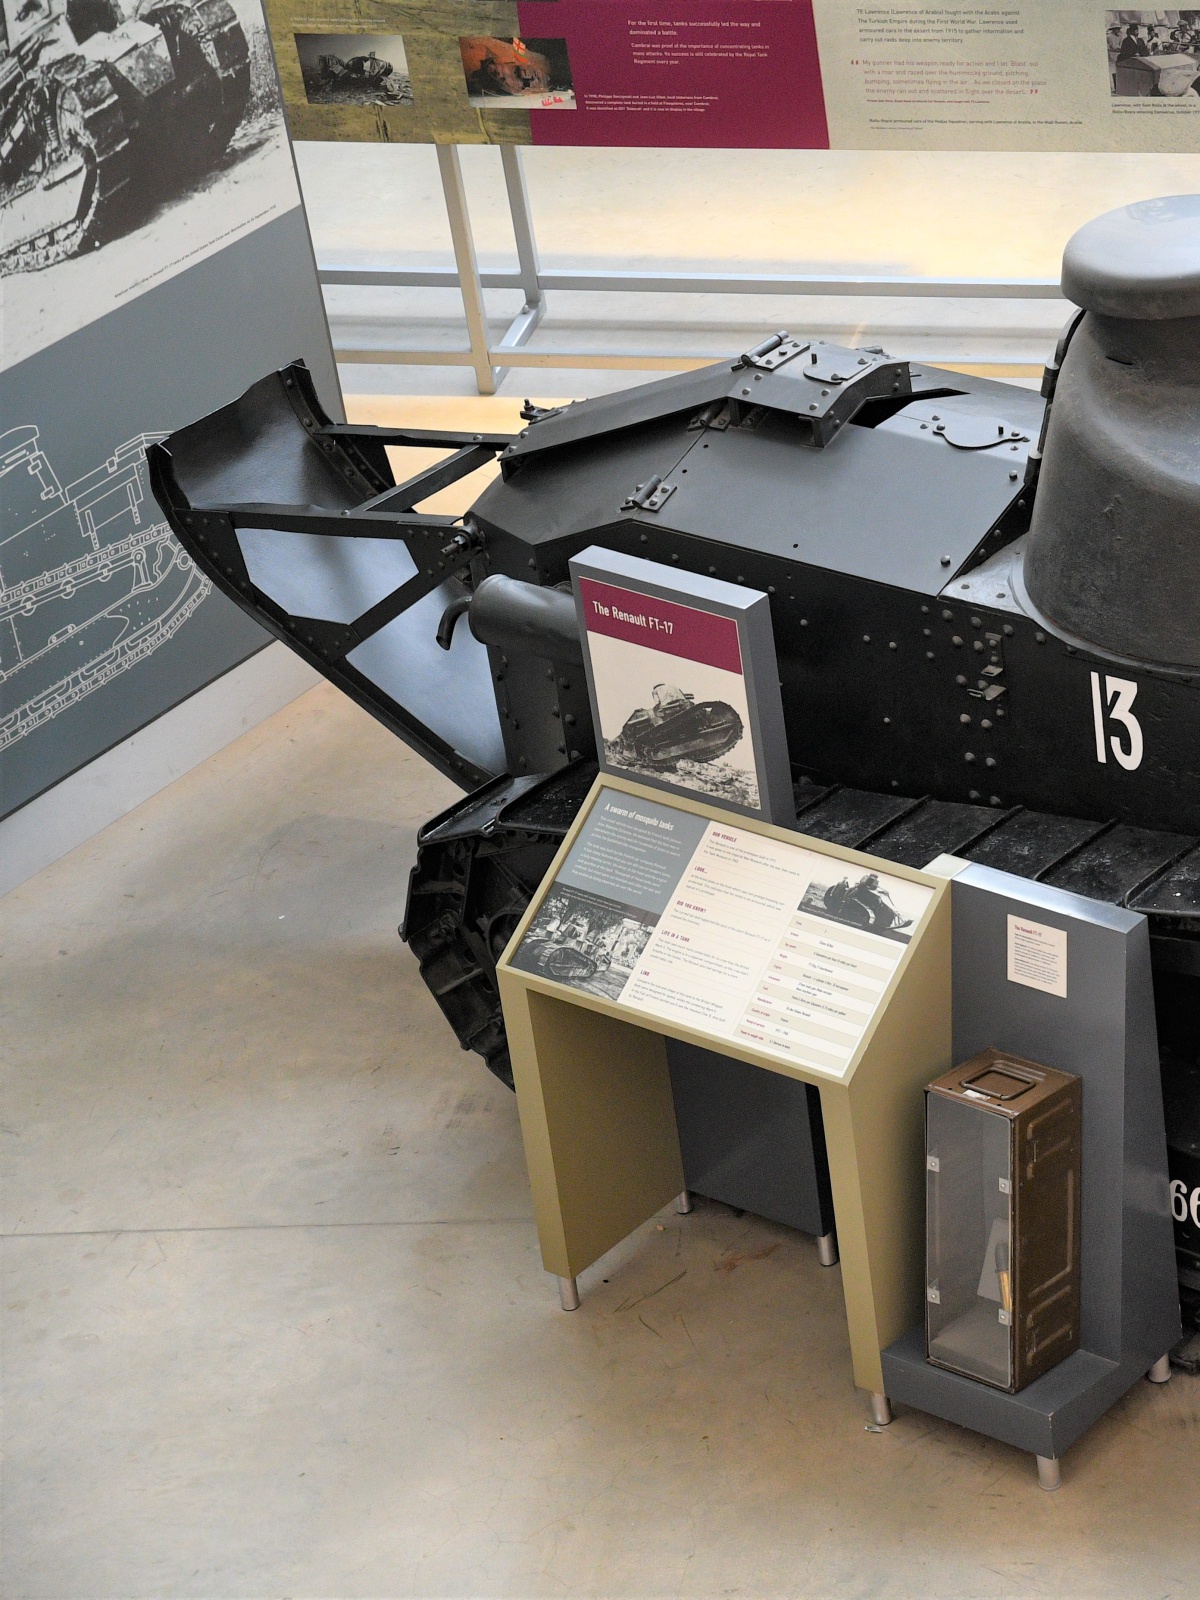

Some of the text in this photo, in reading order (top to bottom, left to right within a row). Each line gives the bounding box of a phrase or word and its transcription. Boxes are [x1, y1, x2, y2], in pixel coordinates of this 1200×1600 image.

[593, 601, 674, 635] The Renault FT-17
[1090, 670, 1144, 771] 13
[610, 806, 628, 816] swarm
[635, 815, 659, 826] mosquito
[658, 820, 674, 831] tanks
[721, 834, 738, 843] VEHICLE
[692, 905, 706, 913] KNOW?
